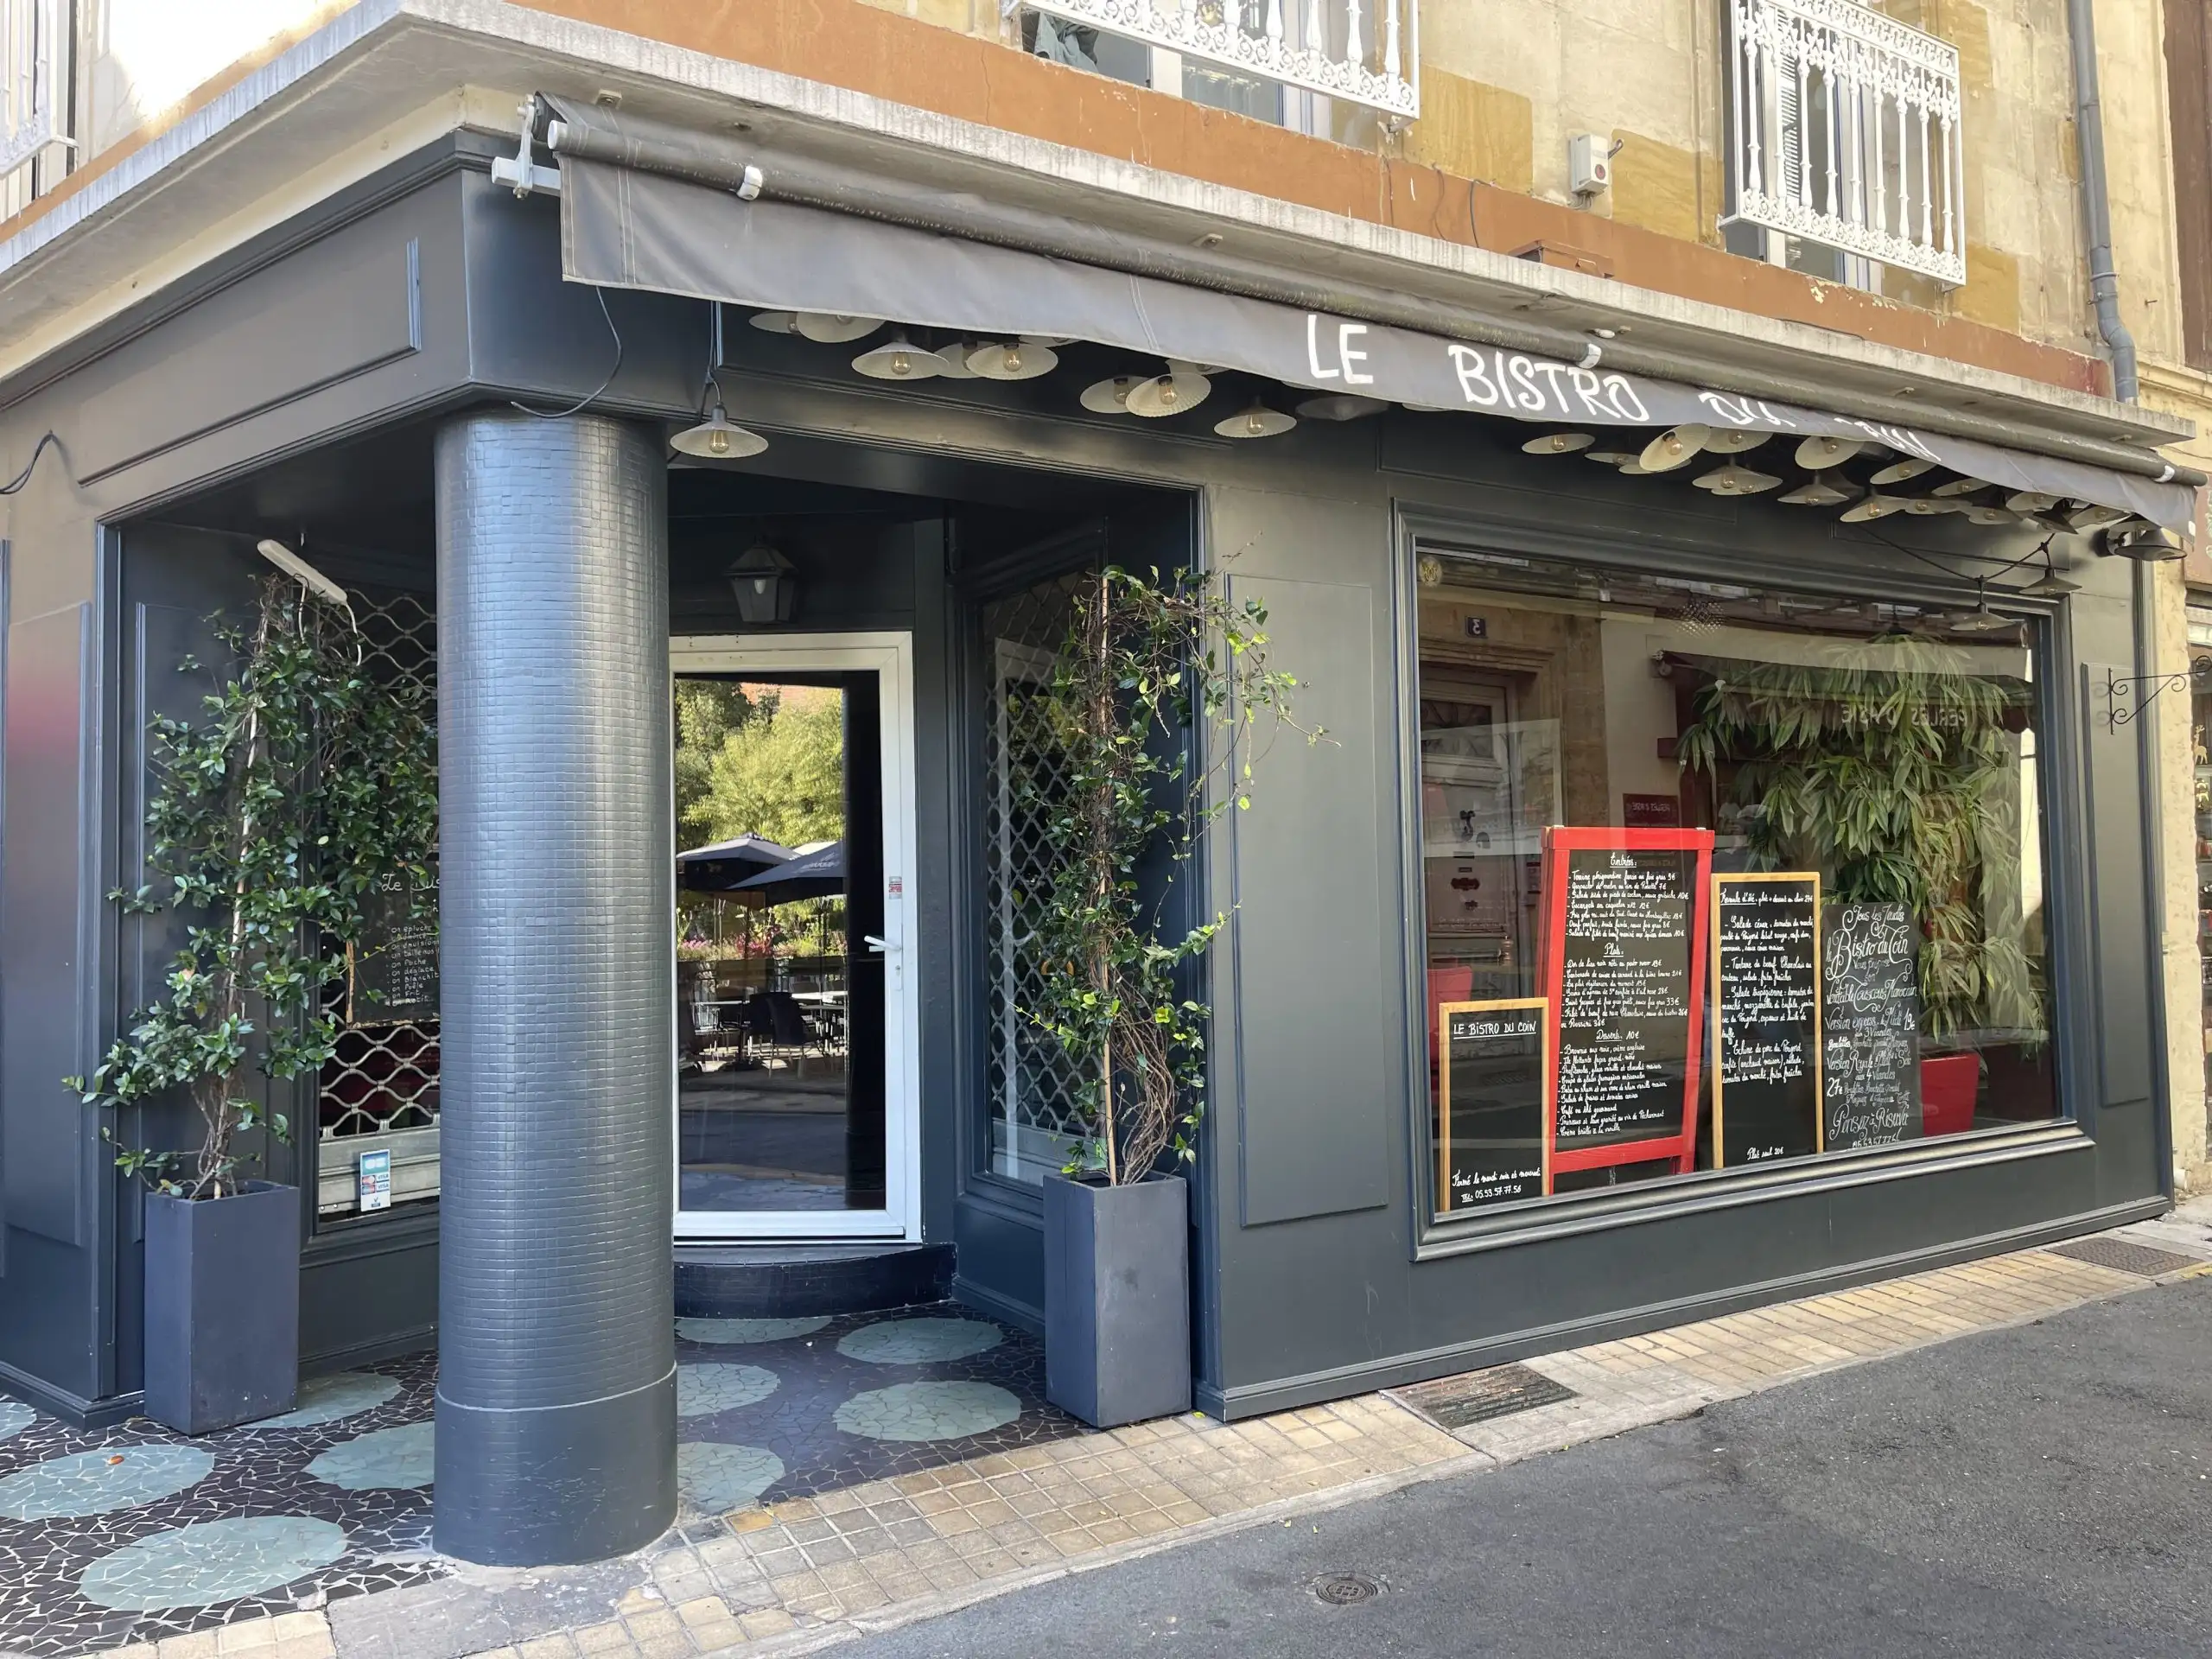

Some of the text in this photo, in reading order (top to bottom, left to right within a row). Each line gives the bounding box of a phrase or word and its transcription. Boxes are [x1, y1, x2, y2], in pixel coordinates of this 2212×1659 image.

[1306, 313, 1374, 385] LE
[1447, 344, 1650, 422] BISTRO
[381, 873, 404, 892] Le
[1731, 915, 1752, 929] Salade
[1827, 925, 1910, 980] Bistro Coin
[1731, 985, 1751, 998] Salade
[1666, 996, 1681, 1007] 33€
[1568, 1017, 1592, 1028] Rossini
[1825, 1006, 1916, 1031] Version 19€
[1453, 1024, 1465, 1035] LE
[1503, 1022, 1515, 1033] DU
[1625, 1030, 1640, 1040] 10€
[1864, 1027, 1870, 1037] 3
[1827, 1048, 1851, 1071] Version
[1866, 1068, 1872, 1084] 4
[1827, 1077, 1843, 1097] 27€
[1746, 1147, 1760, 1160] Plat
[1452, 1169, 1471, 1187] Fermé
[1472, 1172, 1480, 1185] le
[1480, 1171, 1498, 1183] mardi
[1510, 1170, 1518, 1179] et
